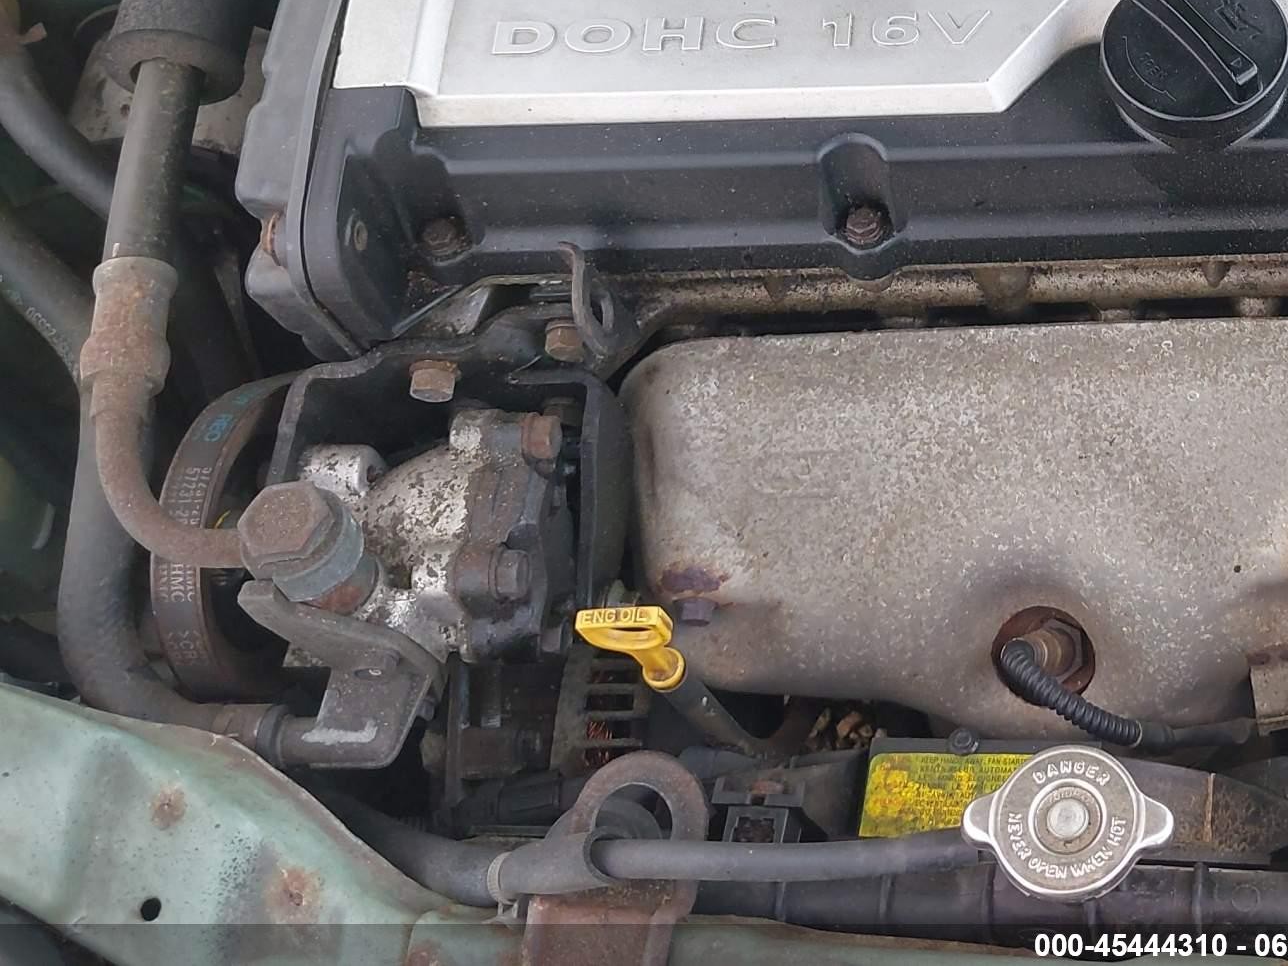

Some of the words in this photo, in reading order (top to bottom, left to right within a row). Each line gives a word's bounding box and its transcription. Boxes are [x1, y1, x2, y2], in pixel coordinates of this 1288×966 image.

[491, 16, 778, 55] DOHC
[822, 10, 990, 48] 16V
[582, 610, 616, 625] ENG
[620, 608, 648, 622] OIL
[1031, 759, 1112, 787] DANGER
[1007, 811, 1033, 861] NEVER
[1028, 856, 1068, 880] OPEN
[1069, 842, 1114, 878] WHEN
[1107, 815, 1128, 852] HOT
